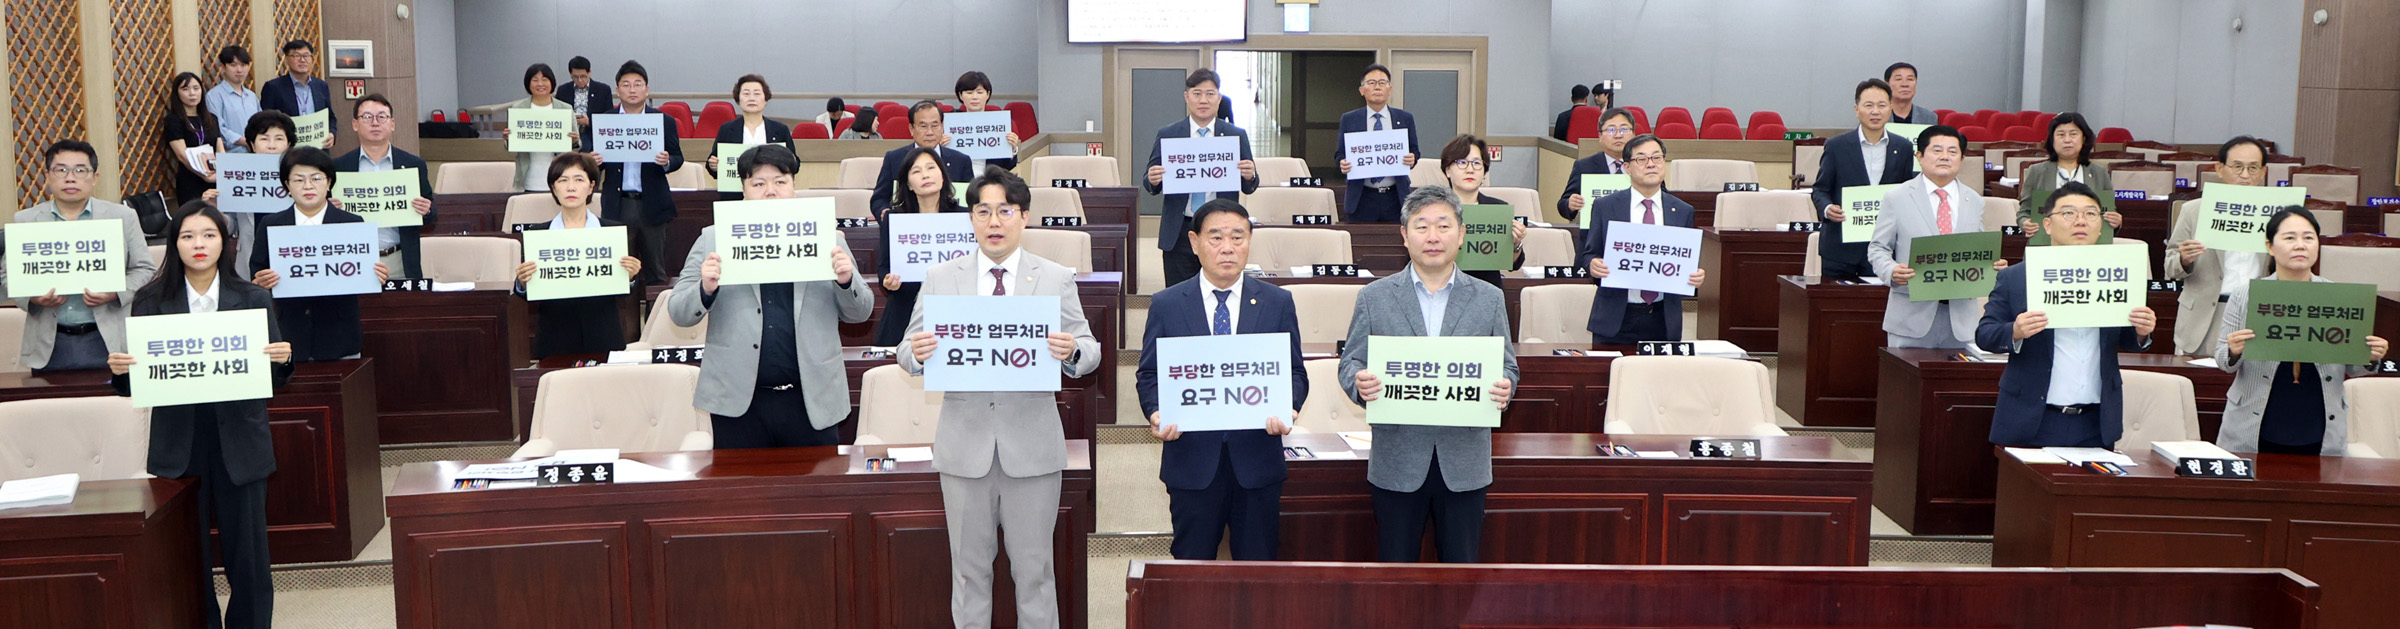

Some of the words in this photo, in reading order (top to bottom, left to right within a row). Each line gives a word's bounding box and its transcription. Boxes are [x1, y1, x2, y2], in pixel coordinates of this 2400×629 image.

[517, 120, 543, 129] 투명한
[545, 120, 562, 129] 의회
[949, 126, 973, 135] 부당한
[975, 124, 1006, 134] 업무처리
[296, 134, 312, 143] 끗한
[517, 131, 543, 140] 깨끗한
[545, 131, 562, 140] 사회
[598, 127, 623, 137] 부당한
[626, 127, 658, 136] 업무처리
[605, 141, 625, 150] 요구
[956, 139, 974, 148] 요구
[1350, 145, 1372, 154] 부당한
[1374, 142, 1404, 152] 업무처리
[1168, 153, 1195, 163] 부당한
[1198, 152, 1234, 162] 업무처리
[1356, 157, 1373, 167] 요구
[223, 170, 256, 181] 부당한
[260, 170, 280, 180] 업무
[1175, 169, 1197, 179] 요구
[232, 185, 257, 197] 요구
[262, 186, 289, 199] NO
[343, 186, 379, 198] 투명한
[383, 185, 407, 196] 의회
[344, 201, 380, 212] 깨끗한
[384, 200, 408, 211] 사회
[2213, 201, 2257, 217] 투명한
[731, 222, 780, 239] 투명한
[786, 221, 818, 237] 의회
[836, 219, 865, 228] 준숙
[1465, 224, 1507, 235] 업무처리
[1793, 222, 1822, 231] 윤경
[2211, 218, 2254, 233] 깨끗한
[897, 233, 931, 245] 부당한
[21, 241, 70, 257] 투명한
[75, 239, 106, 255] 의회
[278, 246, 317, 258] 부당한
[321, 243, 370, 257] 업무처리
[538, 247, 580, 262] 투명한
[585, 246, 612, 260] 의회
[732, 244, 781, 260] 깨끗한
[786, 243, 818, 258] 사회
[1612, 240, 1647, 253] 부당한
[1649, 244, 1692, 259] 업무처리
[906, 251, 933, 263] 요구
[1915, 252, 1949, 265] 부당한
[1951, 250, 1993, 262] 업무처리
[22, 260, 71, 275] 깨끗한
[76, 259, 107, 273] 사회
[289, 264, 319, 278] 요구
[539, 265, 581, 280] 깨끗한
[586, 264, 613, 277] 사회
[1547, 267, 1587, 278] 박현수
[1617, 259, 1644, 272] 요구
[1923, 269, 1949, 283] 요구
[2043, 267, 2091, 283] 투명한
[2097, 267, 2128, 282] 의회
[385, 280, 429, 291] 오세철
[2151, 281, 2183, 291] 조미
[2043, 289, 2091, 304] 깨끗한
[2096, 289, 2128, 304] 사회
[2257, 303, 2302, 318] 부당한
[2307, 305, 2365, 321] 업무처리
[934, 323, 982, 339] 부당한
[988, 323, 1049, 339] 업무처리
[2265, 325, 2301, 341] 요구
[147, 335, 204, 357] 투명한
[211, 333, 248, 354] 의회
[1643, 343, 1691, 356] 이재형
[946, 348, 983, 366] 요구
[148, 358, 206, 380] 깨끗한
[212, 358, 250, 378] 사회
[1168, 363, 1215, 380] 부당한
[1220, 361, 1280, 378] 업무처리
[1384, 361, 1441, 379] 투명한
[1446, 361, 1483, 380] 의회
[1180, 388, 1217, 406] 요구
[1384, 384, 1440, 402] 깨끗한
[1445, 384, 1481, 403] 사회
[1698, 441, 1757, 457] 홍종철
[543, 465, 609, 484] 정종윤
[2188, 460, 2248, 476] 현경환
